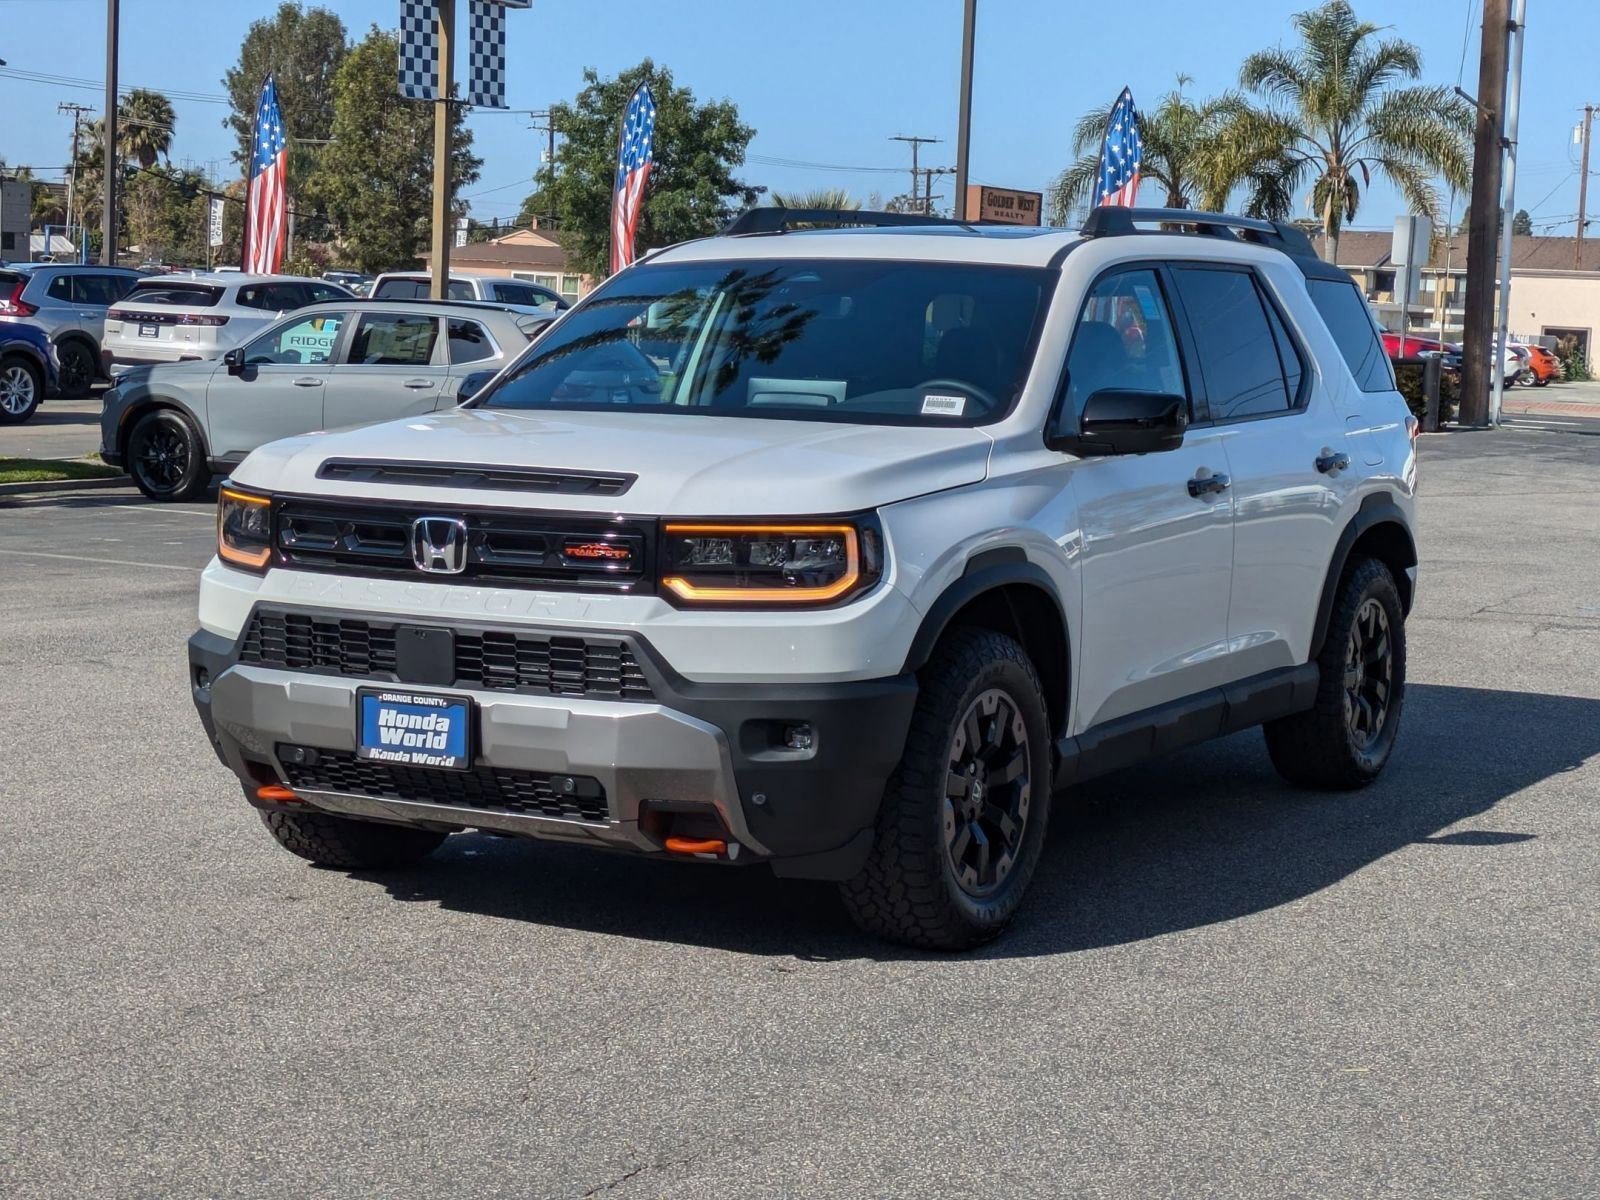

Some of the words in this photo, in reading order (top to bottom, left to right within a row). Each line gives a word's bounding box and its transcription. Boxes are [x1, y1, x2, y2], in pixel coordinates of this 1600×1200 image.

[987, 191, 1015, 209] GOLDEN
[1017, 195, 1035, 211] WEST
[994, 210, 1025, 220] REALTY
[286, 574, 613, 617] PASSPORT
[382, 693, 412, 703] ORANGE
[413, 696, 444, 707] COUNTY
[378, 708, 450, 732] Honda
[380, 726, 448, 750] World
[369, 747, 411, 763] Honda
[411, 752, 456, 767] World
